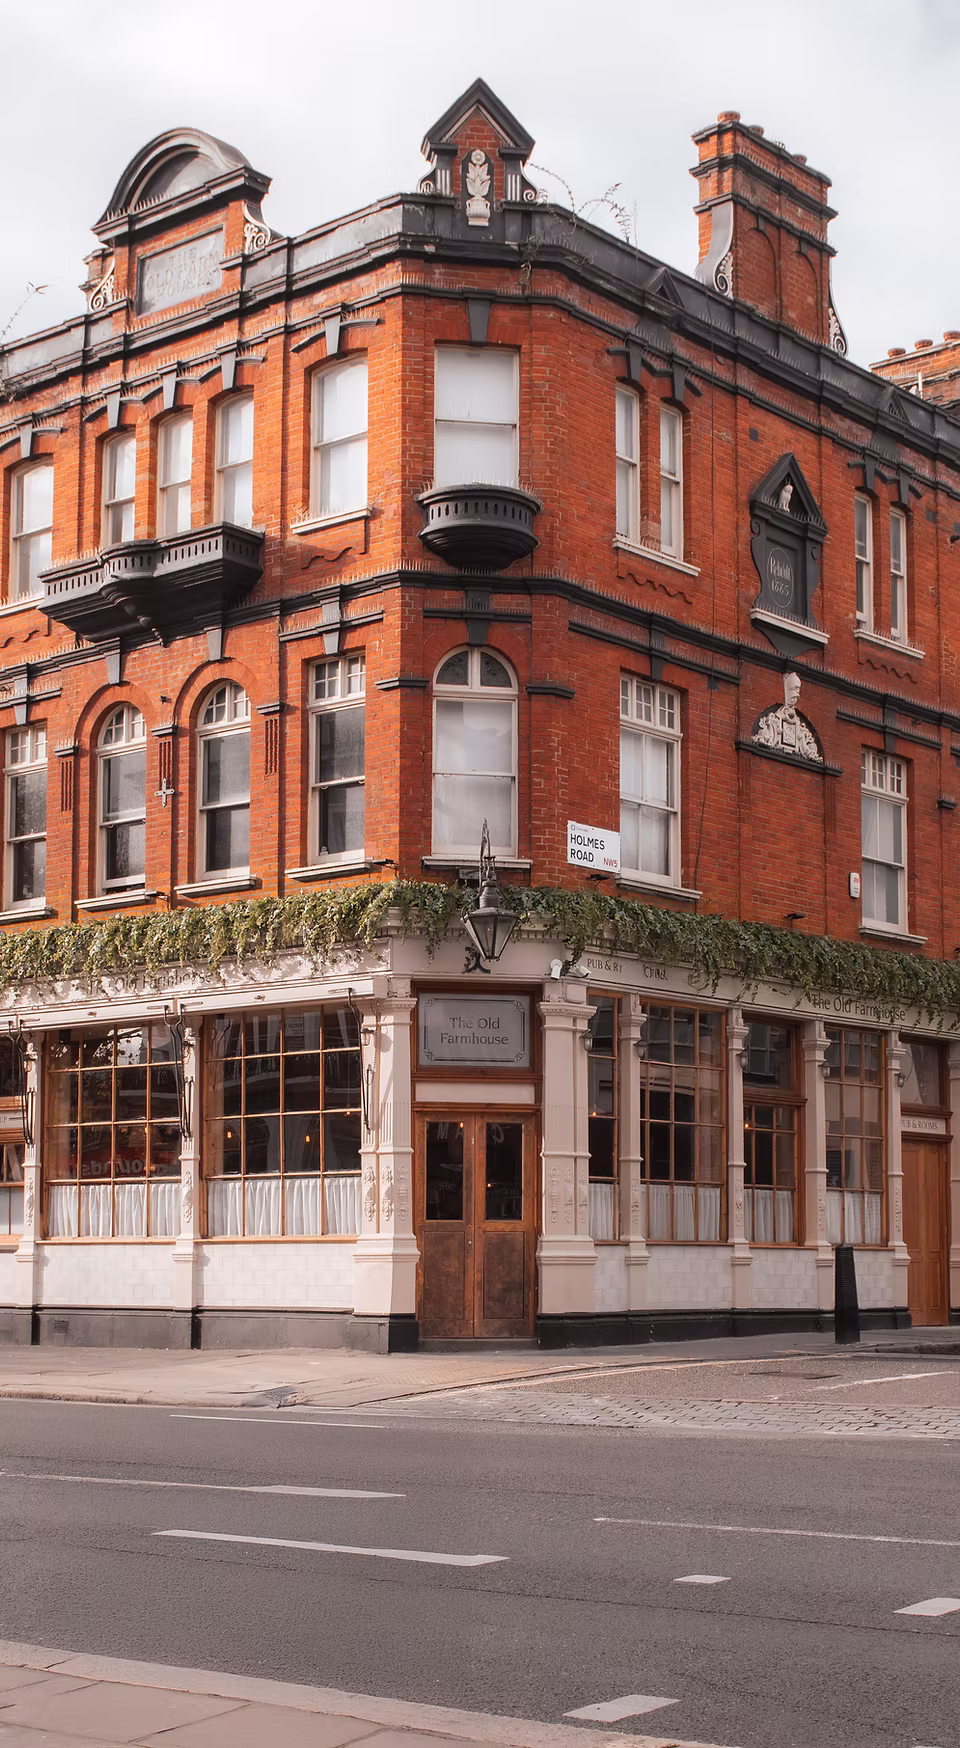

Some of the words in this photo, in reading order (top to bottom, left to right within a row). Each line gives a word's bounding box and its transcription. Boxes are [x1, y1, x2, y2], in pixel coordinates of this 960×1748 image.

[570, 833, 605, 850] HOLMES
[570, 848, 595, 863] ROAD
[603, 857, 618, 868] NW5
[587, 958, 603, 969] PUB
[604, 960, 612, 971] &
[833, 996, 851, 1014] Old
[449, 1017, 473, 1029] The
[477, 1017, 500, 1029] Old
[440, 1032, 509, 1045] Farmhouse
[918, 1120, 937, 1130] ROOMS
